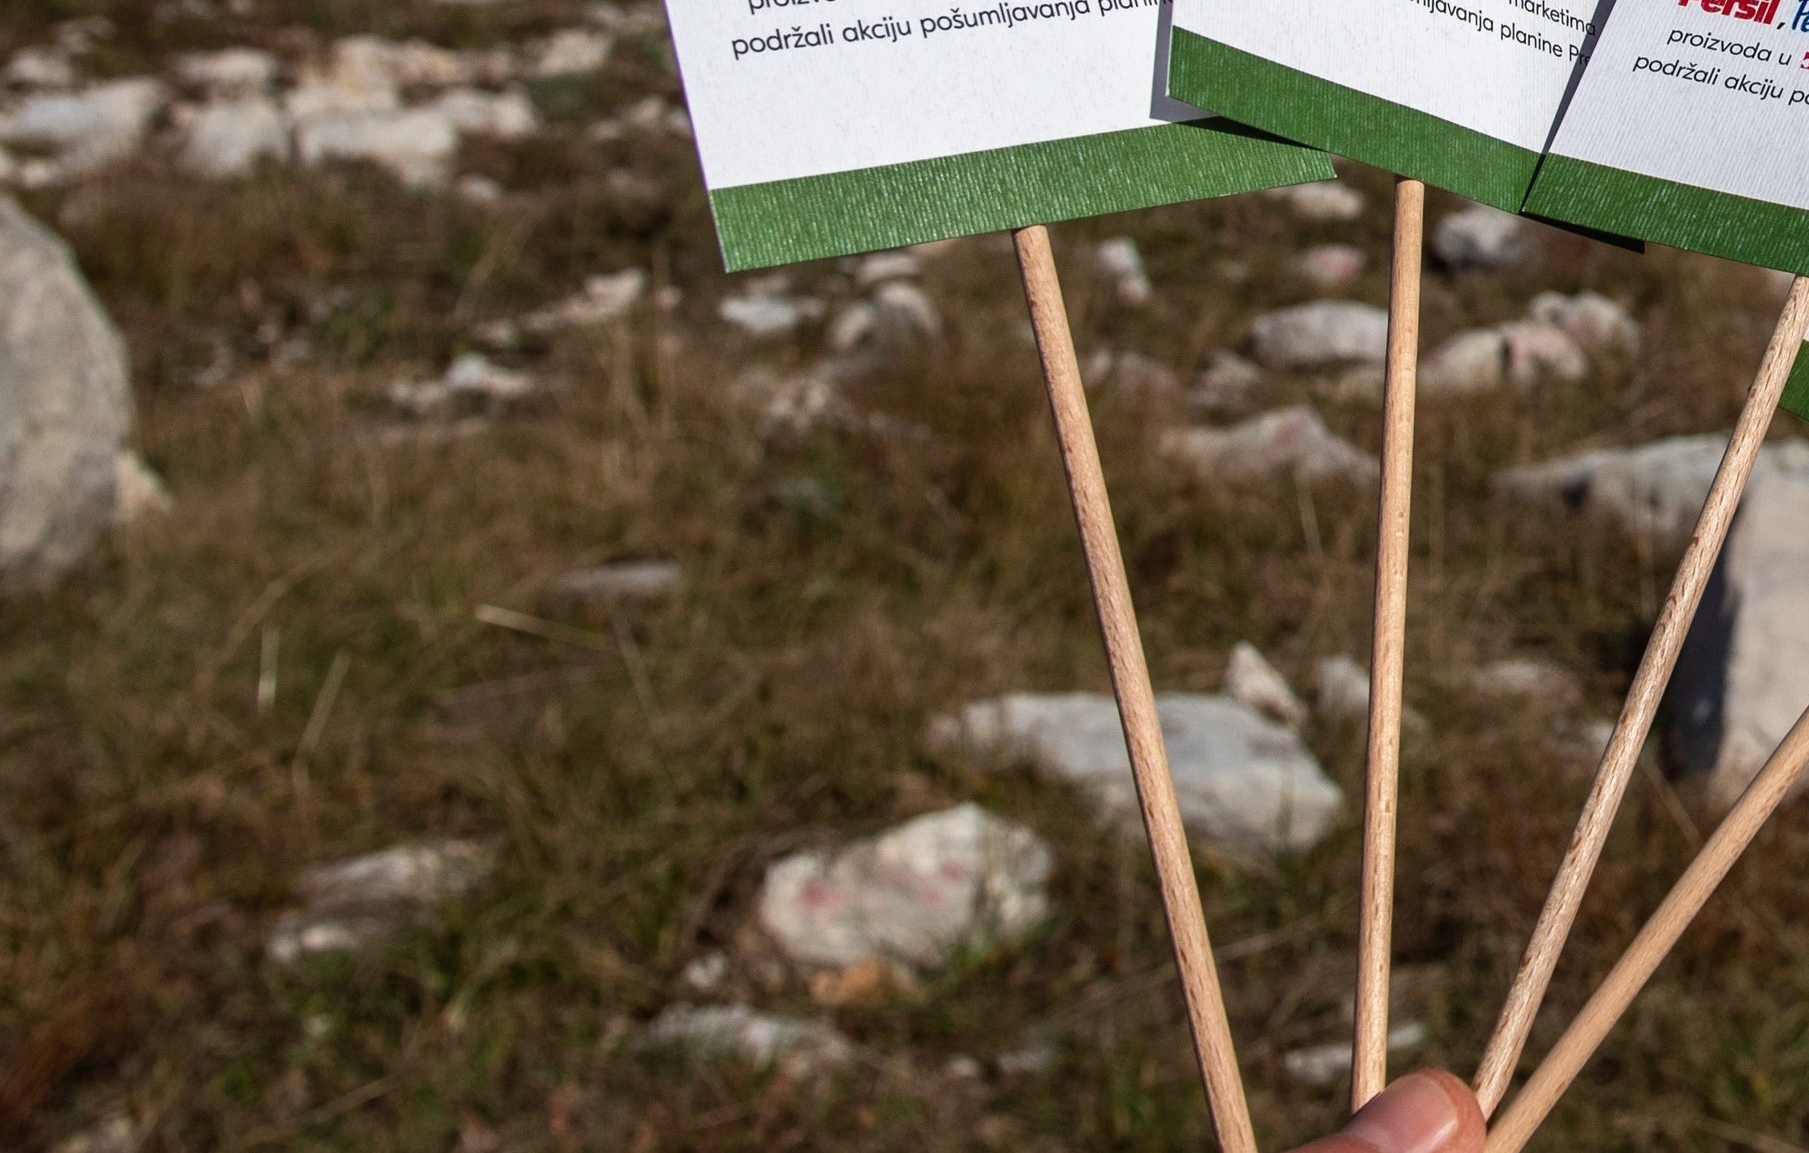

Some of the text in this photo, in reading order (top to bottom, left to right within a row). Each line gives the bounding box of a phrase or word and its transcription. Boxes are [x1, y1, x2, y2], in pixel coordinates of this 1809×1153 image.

[731, 23, 834, 61] podržali
[842, 15, 912, 46] akciju
[1500, 22, 1562, 57] planine
[1666, 26, 1773, 64] proizvoda
[1778, 51, 1792, 66] u
[1632, 52, 1721, 85] podržali
[1724, 73, 1784, 102] akciju
